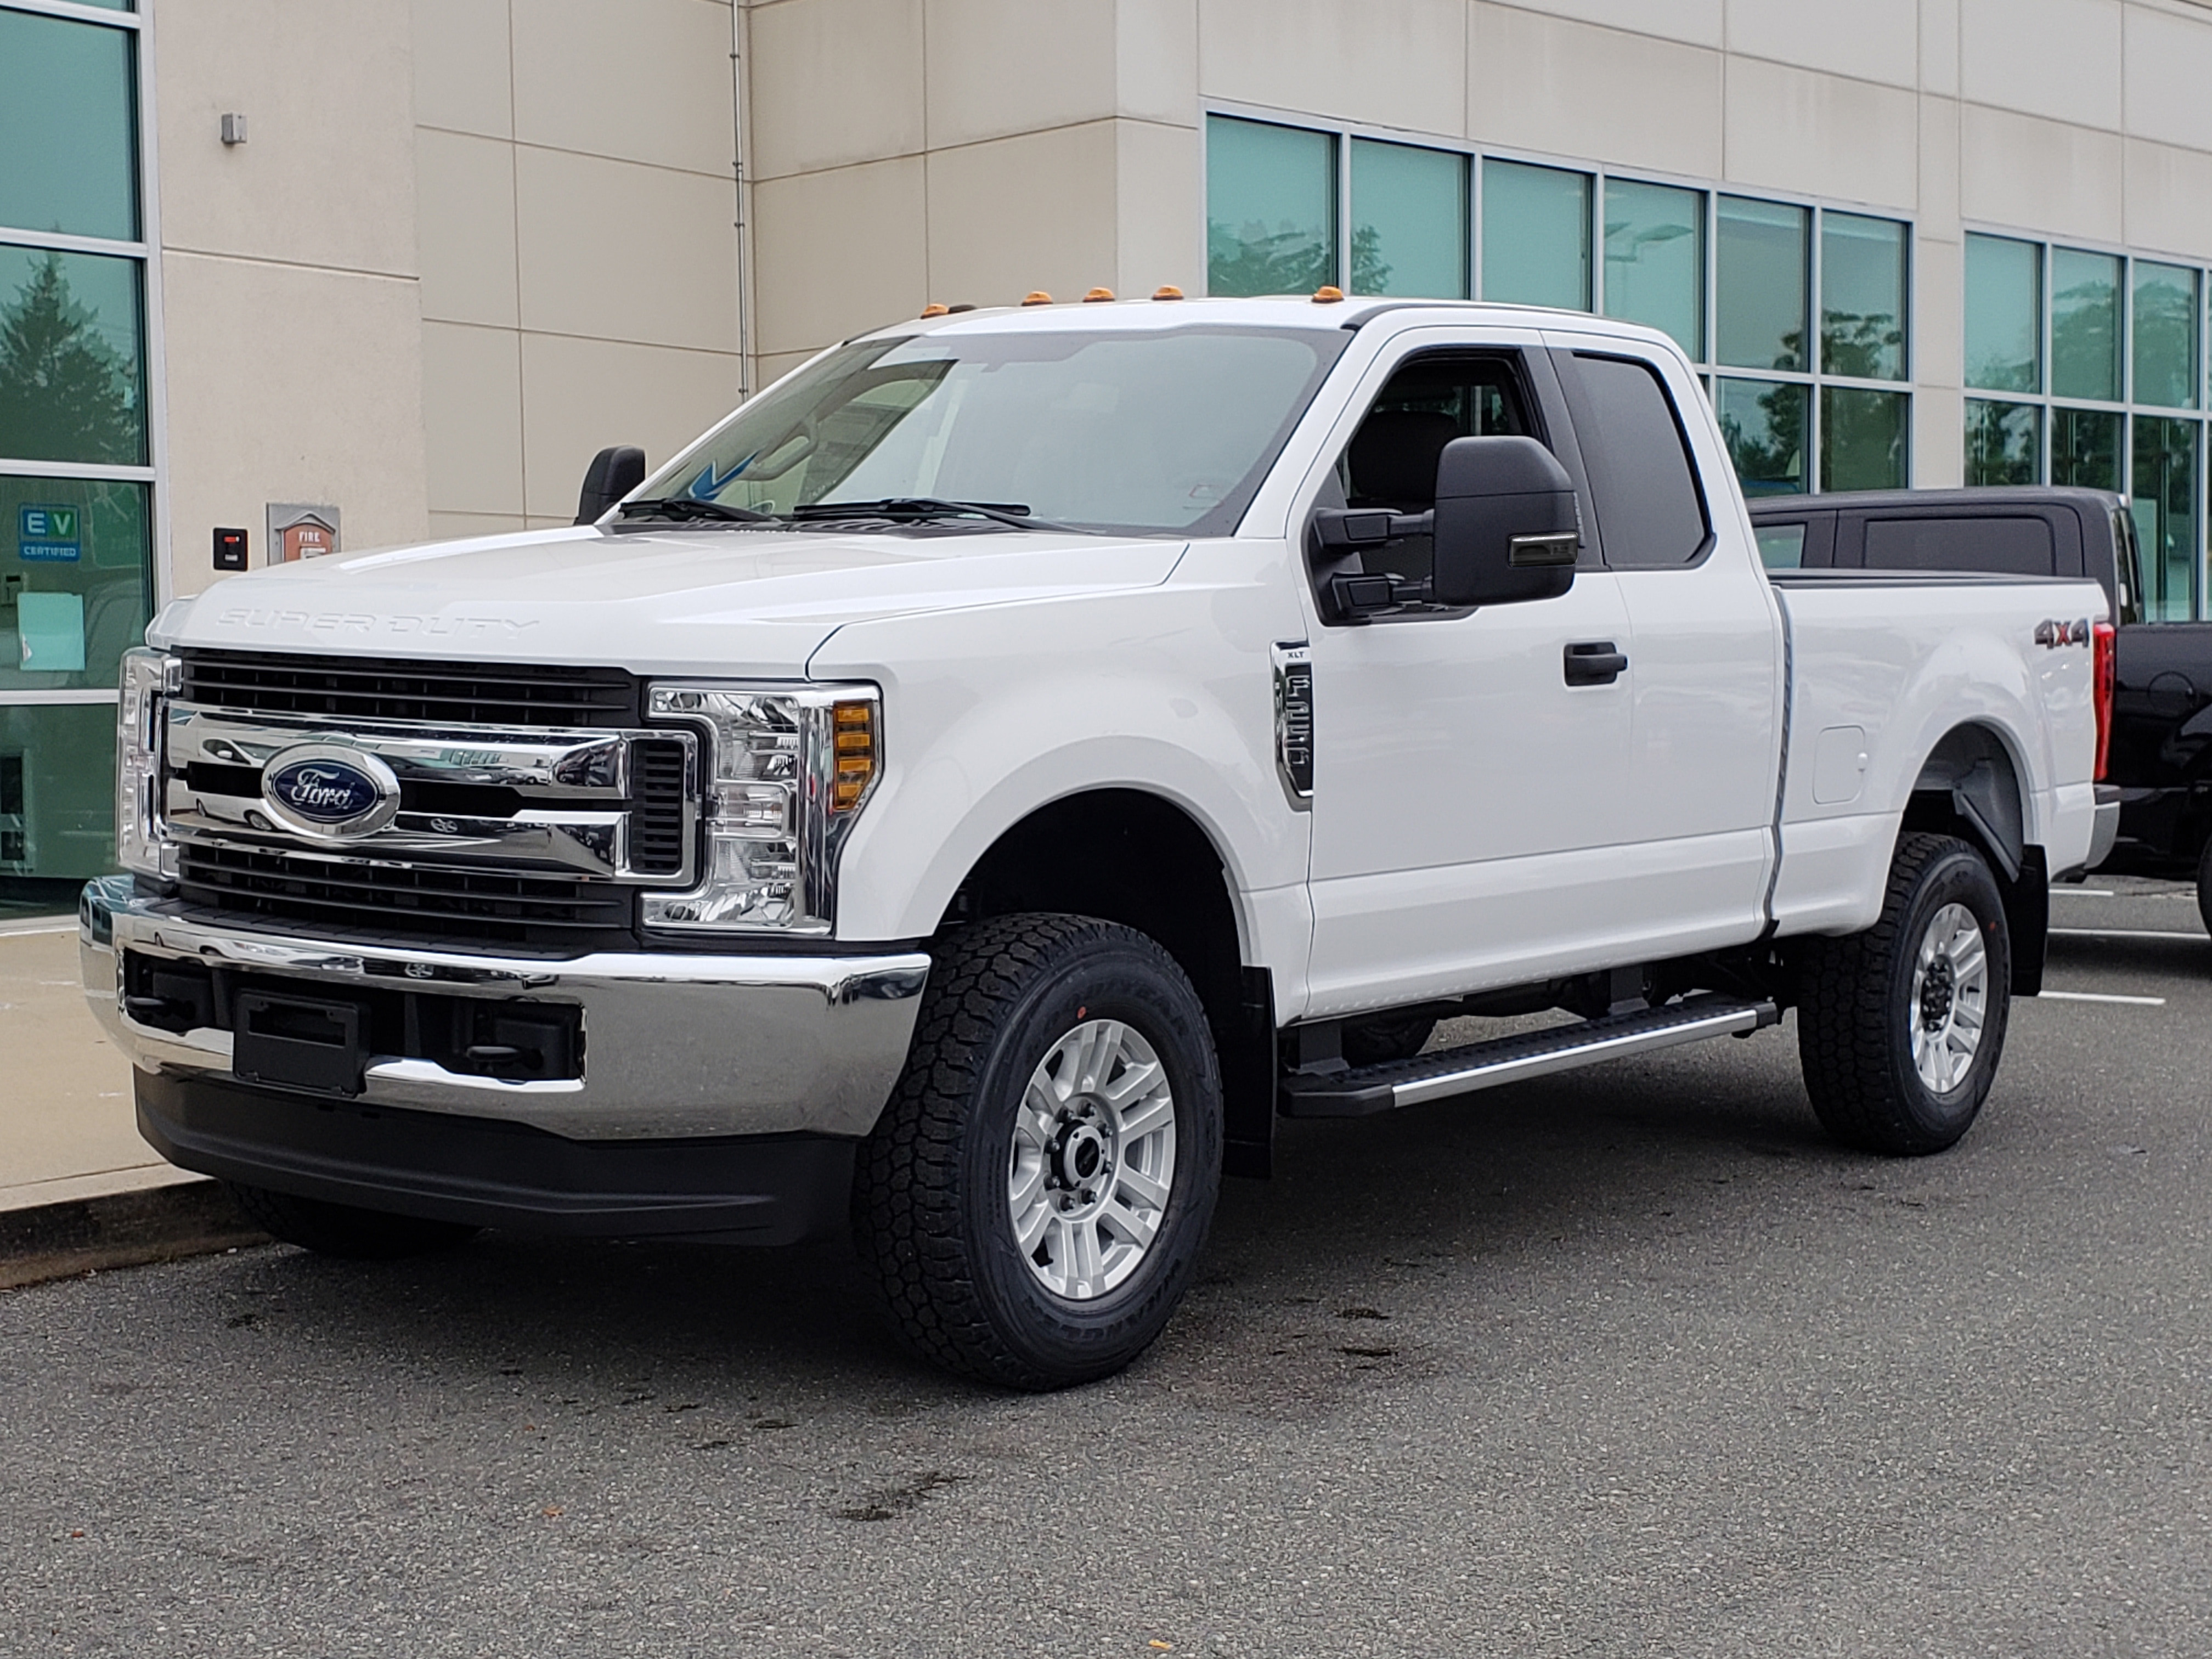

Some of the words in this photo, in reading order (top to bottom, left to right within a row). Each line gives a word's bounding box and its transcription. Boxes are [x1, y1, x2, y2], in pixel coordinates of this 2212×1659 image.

[299, 531, 320, 542] FIRE
[24, 546, 76, 556] CERTIFIED
[216, 608, 377, 633] SUPER
[387, 615, 540, 639] DUTY
[290, 768, 355, 810] Ford
